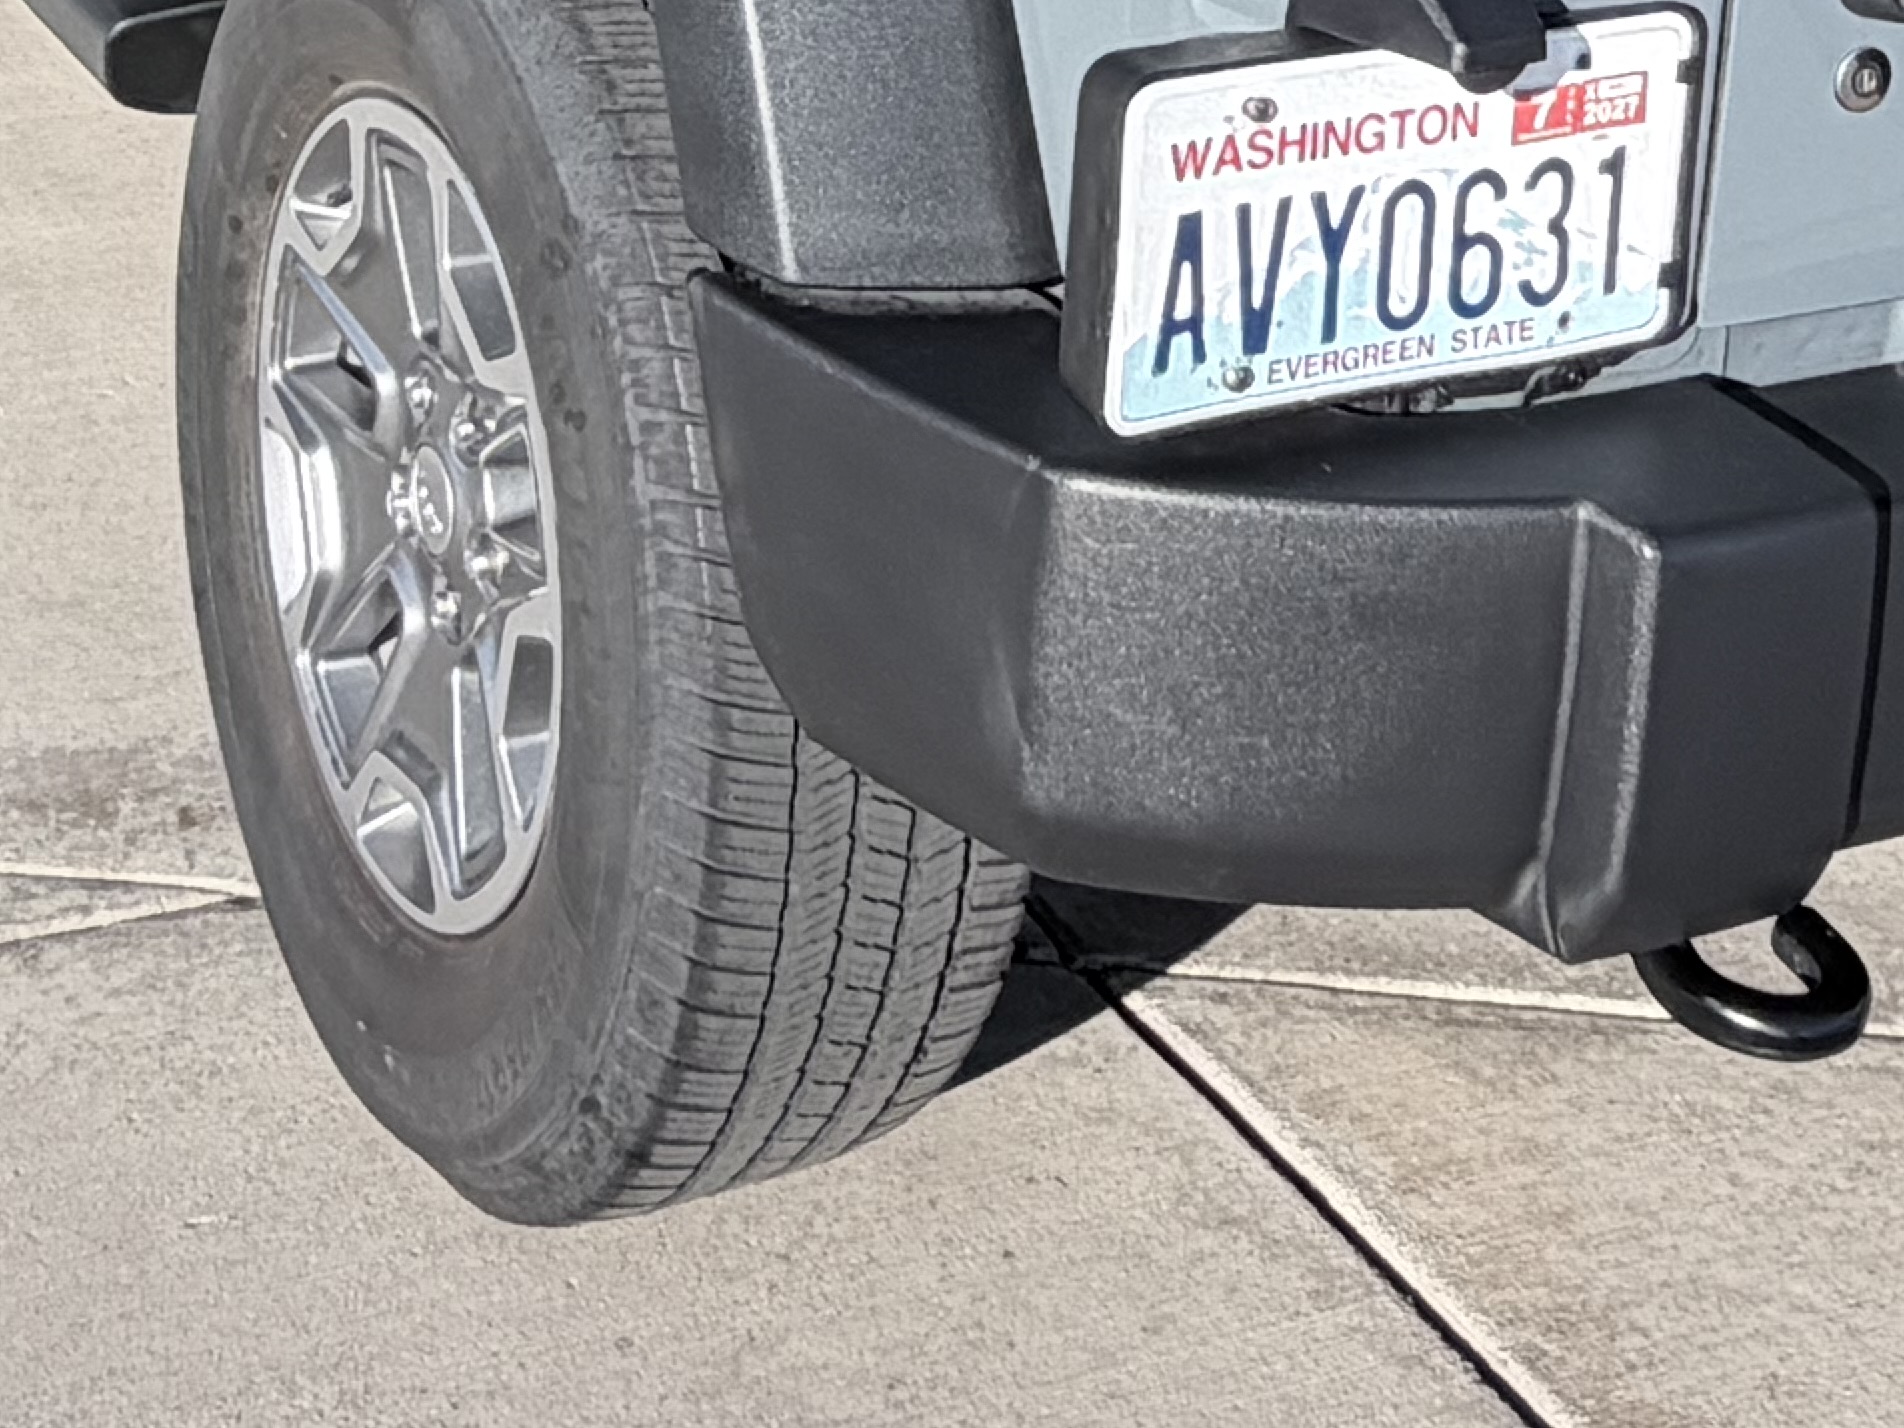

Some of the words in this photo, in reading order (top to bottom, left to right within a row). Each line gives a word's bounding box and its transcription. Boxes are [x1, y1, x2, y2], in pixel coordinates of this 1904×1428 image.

[1171, 101, 1481, 182] WASHINGTON
[1528, 90, 1559, 131] 7
[1582, 95, 1642, 126] 2027
[1151, 144, 1628, 377] AVY0631
[1266, 332, 1437, 387] EVERGREEN
[1448, 317, 1536, 357] STATE
